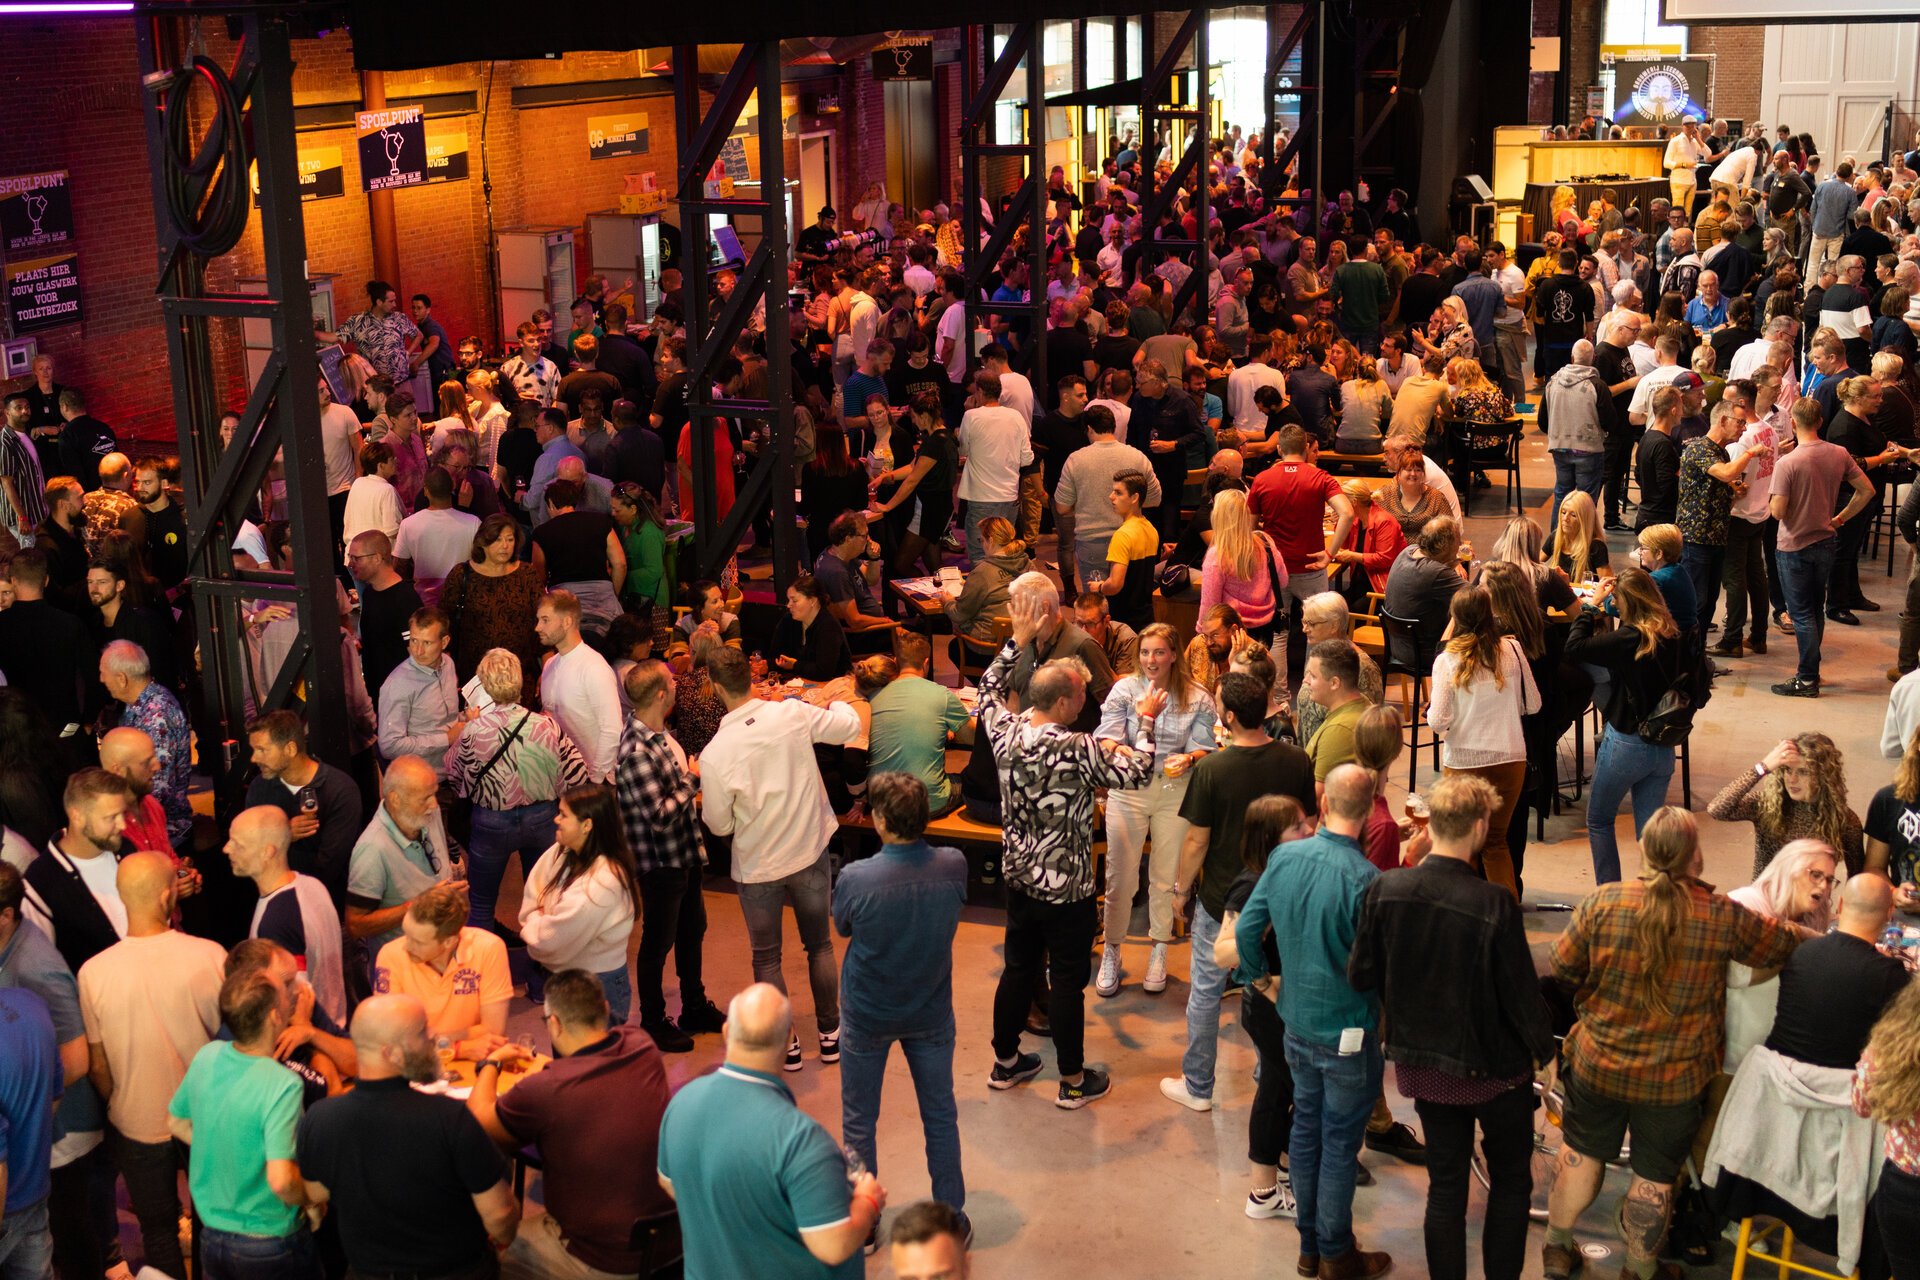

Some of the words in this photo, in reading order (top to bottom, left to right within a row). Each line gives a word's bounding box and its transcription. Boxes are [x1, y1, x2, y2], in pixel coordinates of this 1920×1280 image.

[885, 38, 929, 47] OELPUNT
[819, 94, 839, 111] toilet
[360, 108, 420, 130] SPOELPUNT
[590, 129, 604, 148] 06
[306, 160, 321, 170] TWO
[0, 173, 65, 193] SPOELPUNT
[300, 173, 317, 185] WING
[15, 268, 49, 283] PLAATS
[50, 264, 71, 277] HIER
[11, 284, 34, 297] JOUW
[36, 276, 78, 292] GLASWERK
[34, 291, 59, 305] VOOR
[16, 300, 78, 321] TOILETBEZOEK
